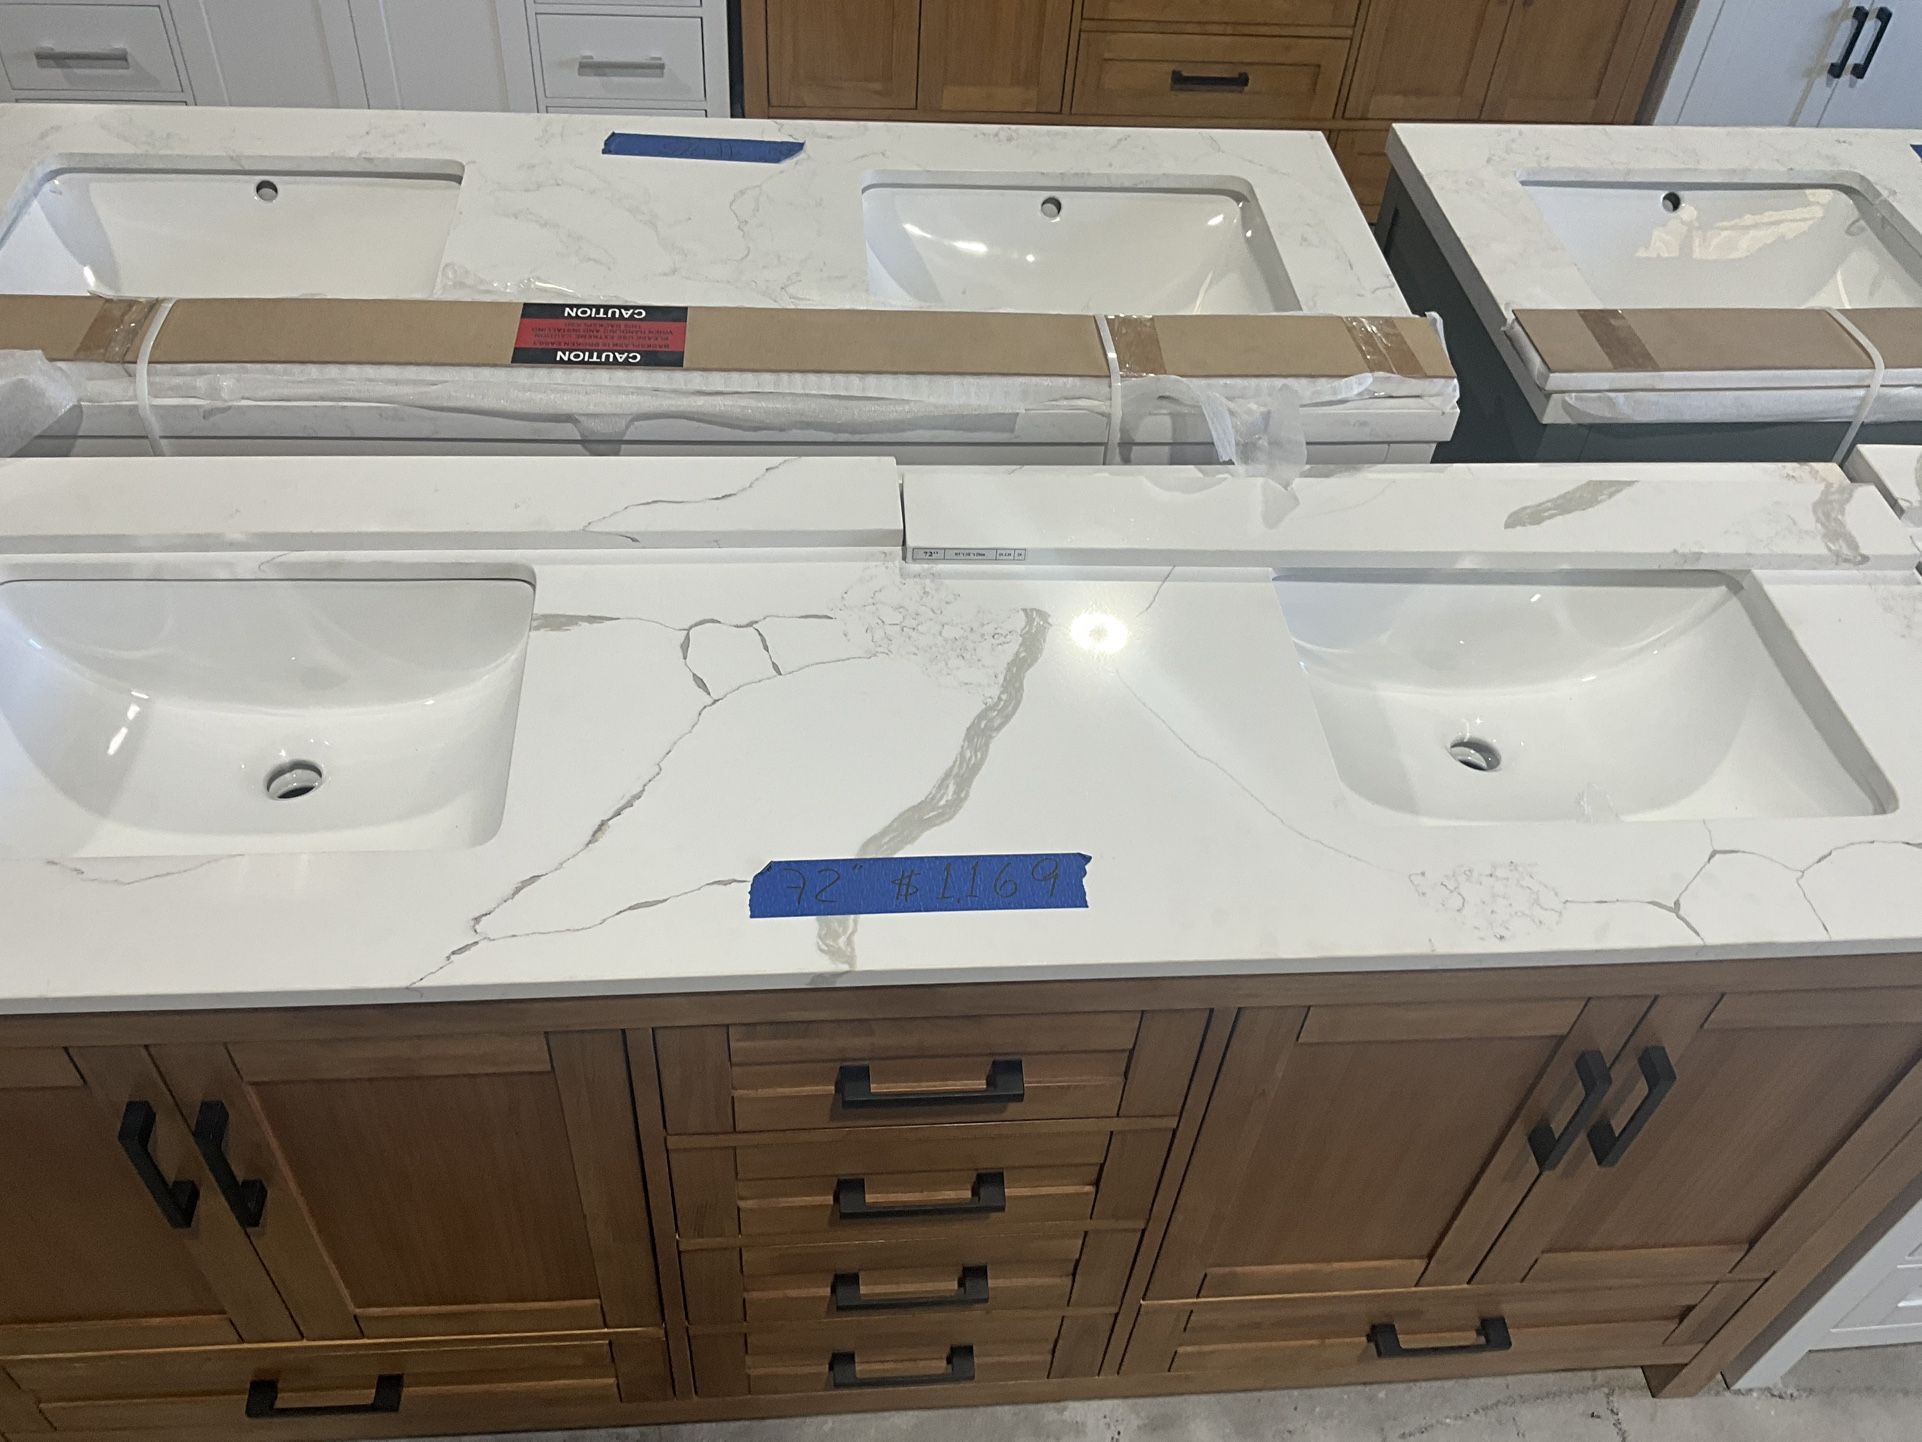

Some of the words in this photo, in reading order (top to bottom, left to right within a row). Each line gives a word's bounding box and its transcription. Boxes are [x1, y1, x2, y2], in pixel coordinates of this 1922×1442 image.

[564, 307, 646, 319] CAUTION
[556, 351, 641, 363] CAUTION
[783, 863, 863, 905] 72"
